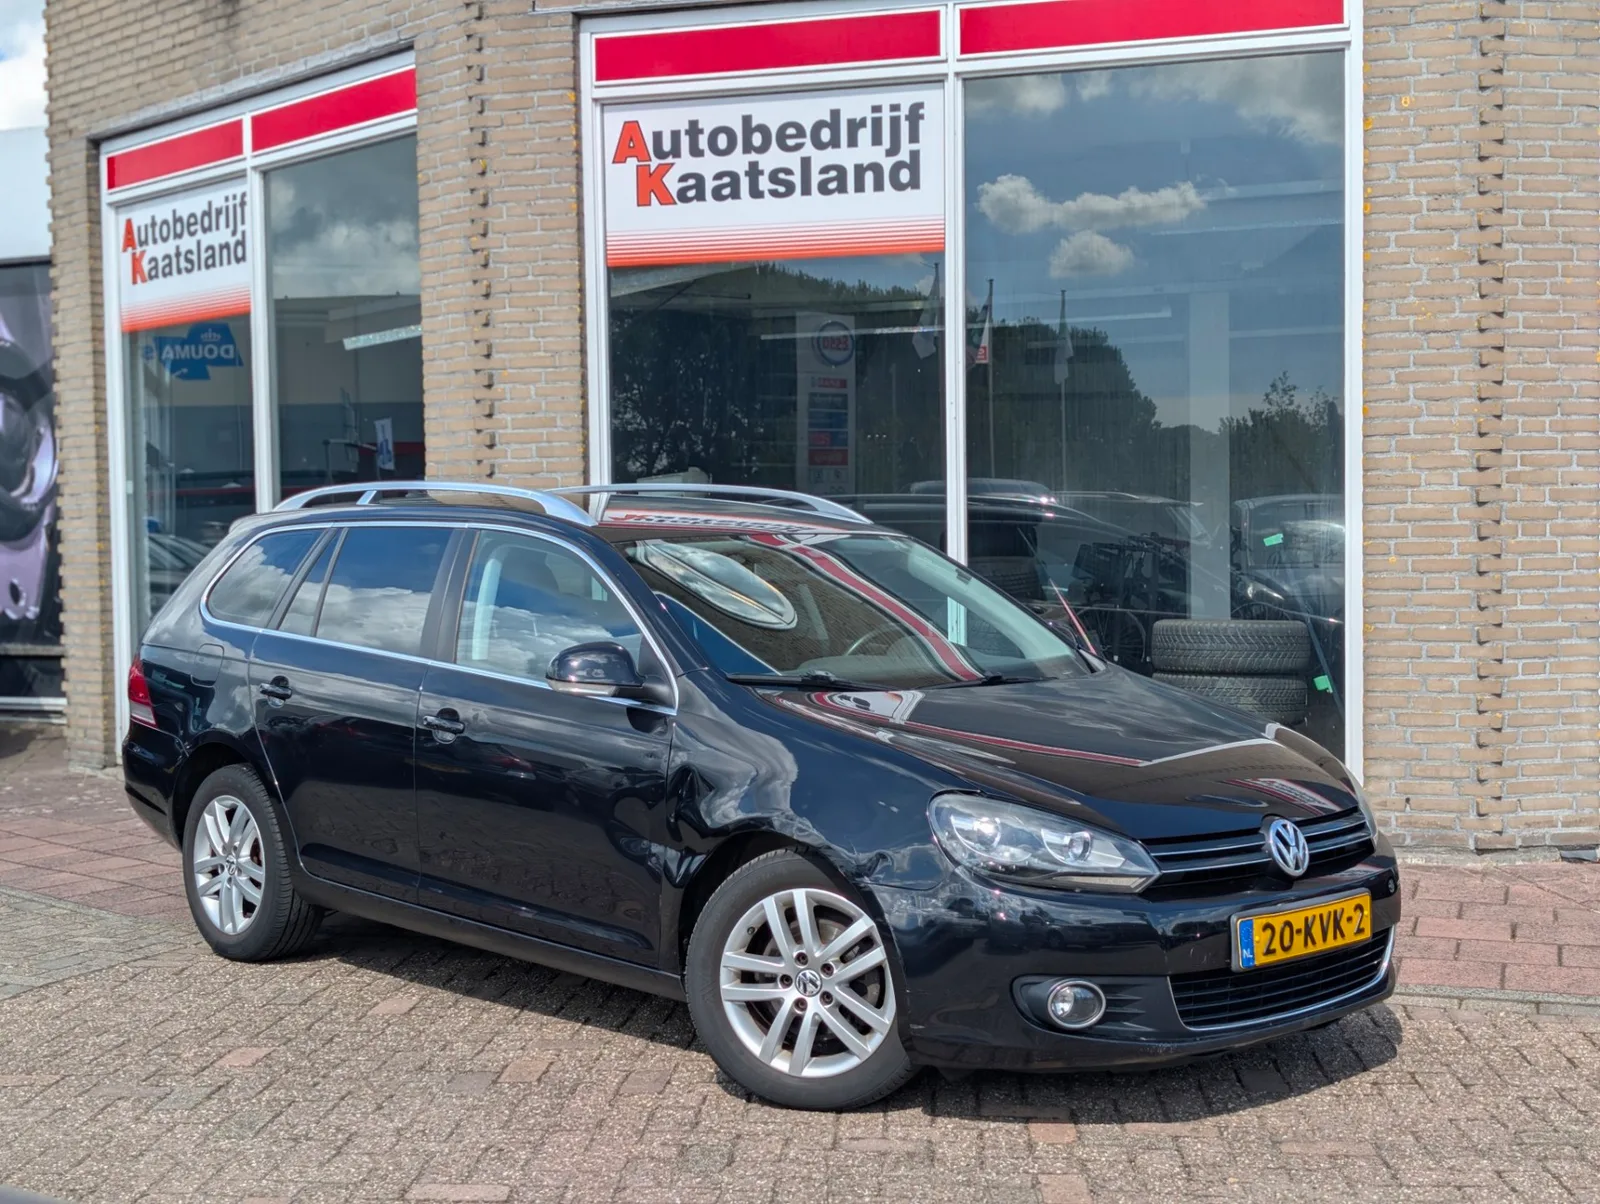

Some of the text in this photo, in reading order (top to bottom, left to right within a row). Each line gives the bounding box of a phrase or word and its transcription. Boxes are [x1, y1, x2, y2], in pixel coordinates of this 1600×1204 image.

[611, 101, 925, 164] Autobedrijf
[636, 149, 921, 207] Kaatsland
[122, 191, 247, 253] Autobedrijf
[132, 229, 247, 285] Kaatsland
[1242, 948, 1253, 959] NL
[1262, 903, 1365, 956] 20-KVK-2
